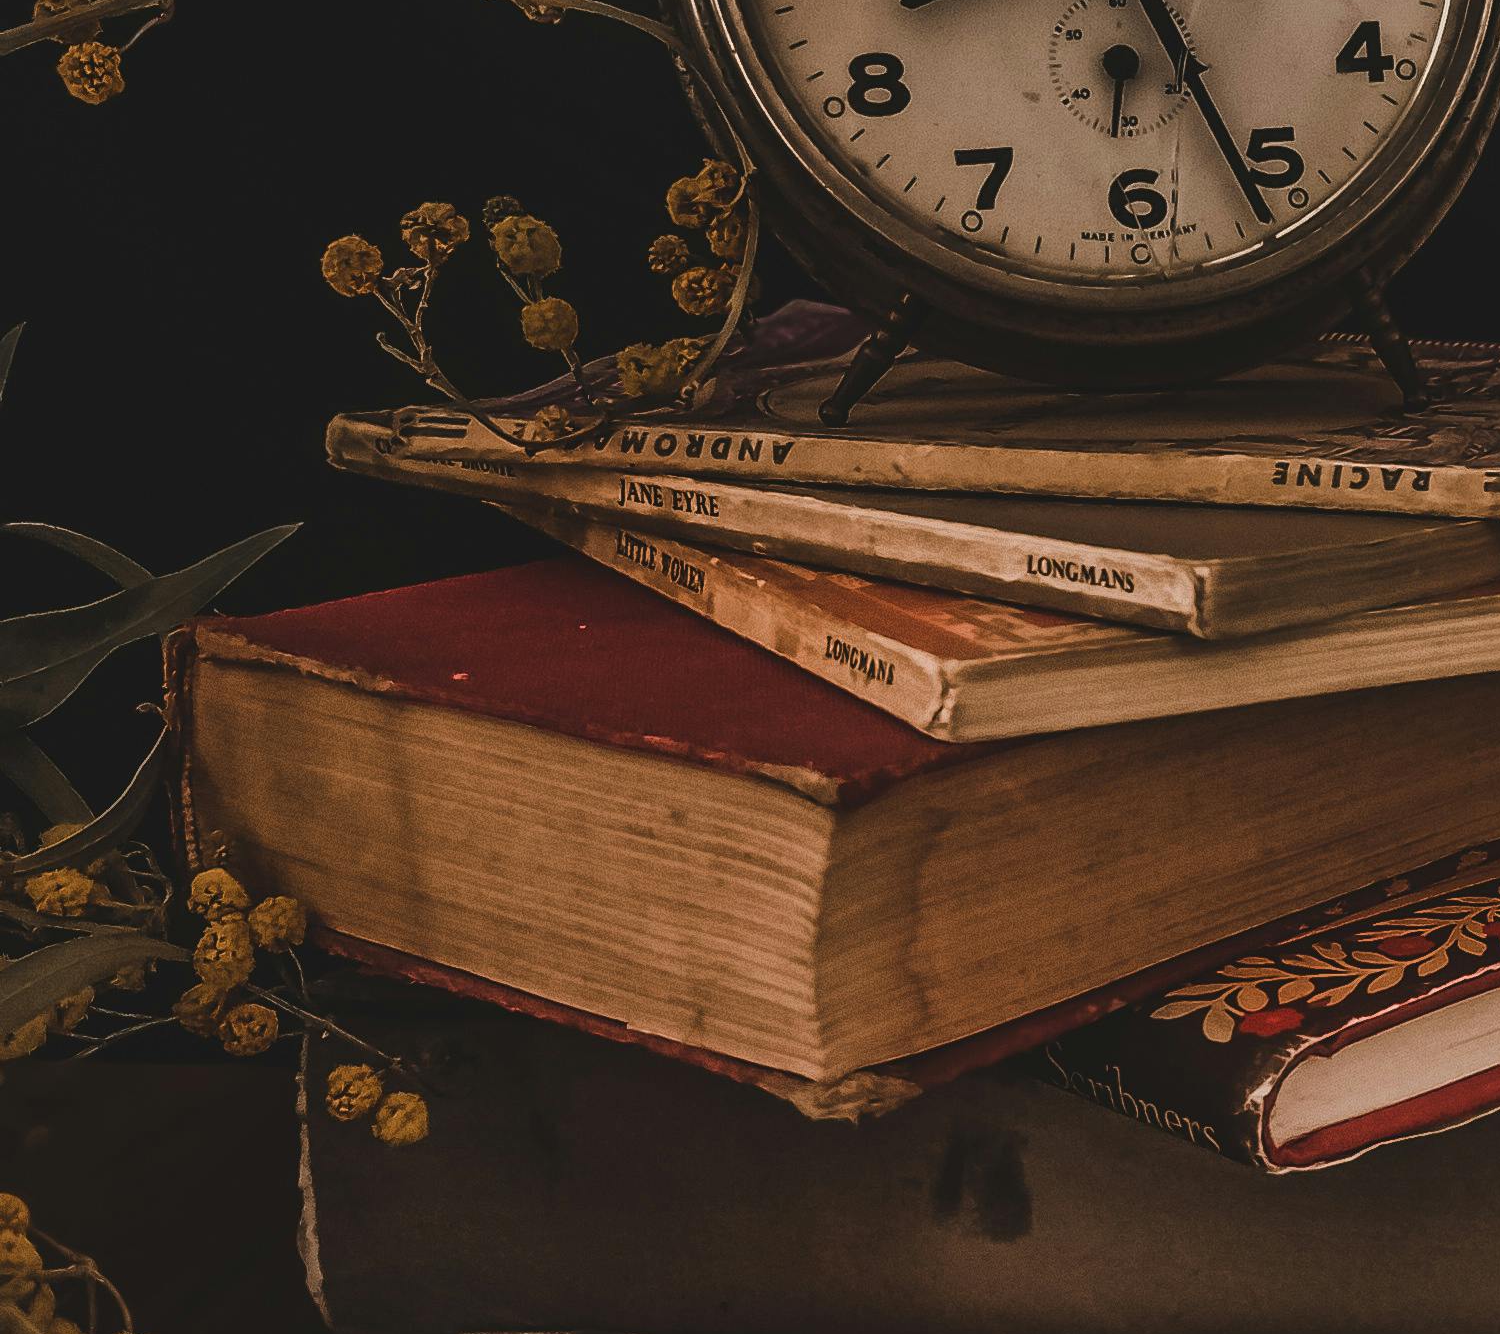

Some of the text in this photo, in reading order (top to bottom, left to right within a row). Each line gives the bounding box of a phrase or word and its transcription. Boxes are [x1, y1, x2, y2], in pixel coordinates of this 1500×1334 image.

[1065, 29, 1083, 41] 50
[1335, 21, 1394, 83] 4
[847, 53, 911, 117] 8
[1071, 88, 1091, 99] 40
[954, 147, 1014, 210] 7
[1246, 126, 1304, 188] 5
[1108, 168, 1168, 229] 6
[1081, 231, 1115, 242] MADE
[618, 476, 720, 517] JANE EYRE
[1271, 461, 1432, 492] RACINE
[616, 529, 705, 594] LITTLE WOMEN
[1026, 554, 1135, 593] LONGMANS
[824, 634, 896, 686] LONGMANS
